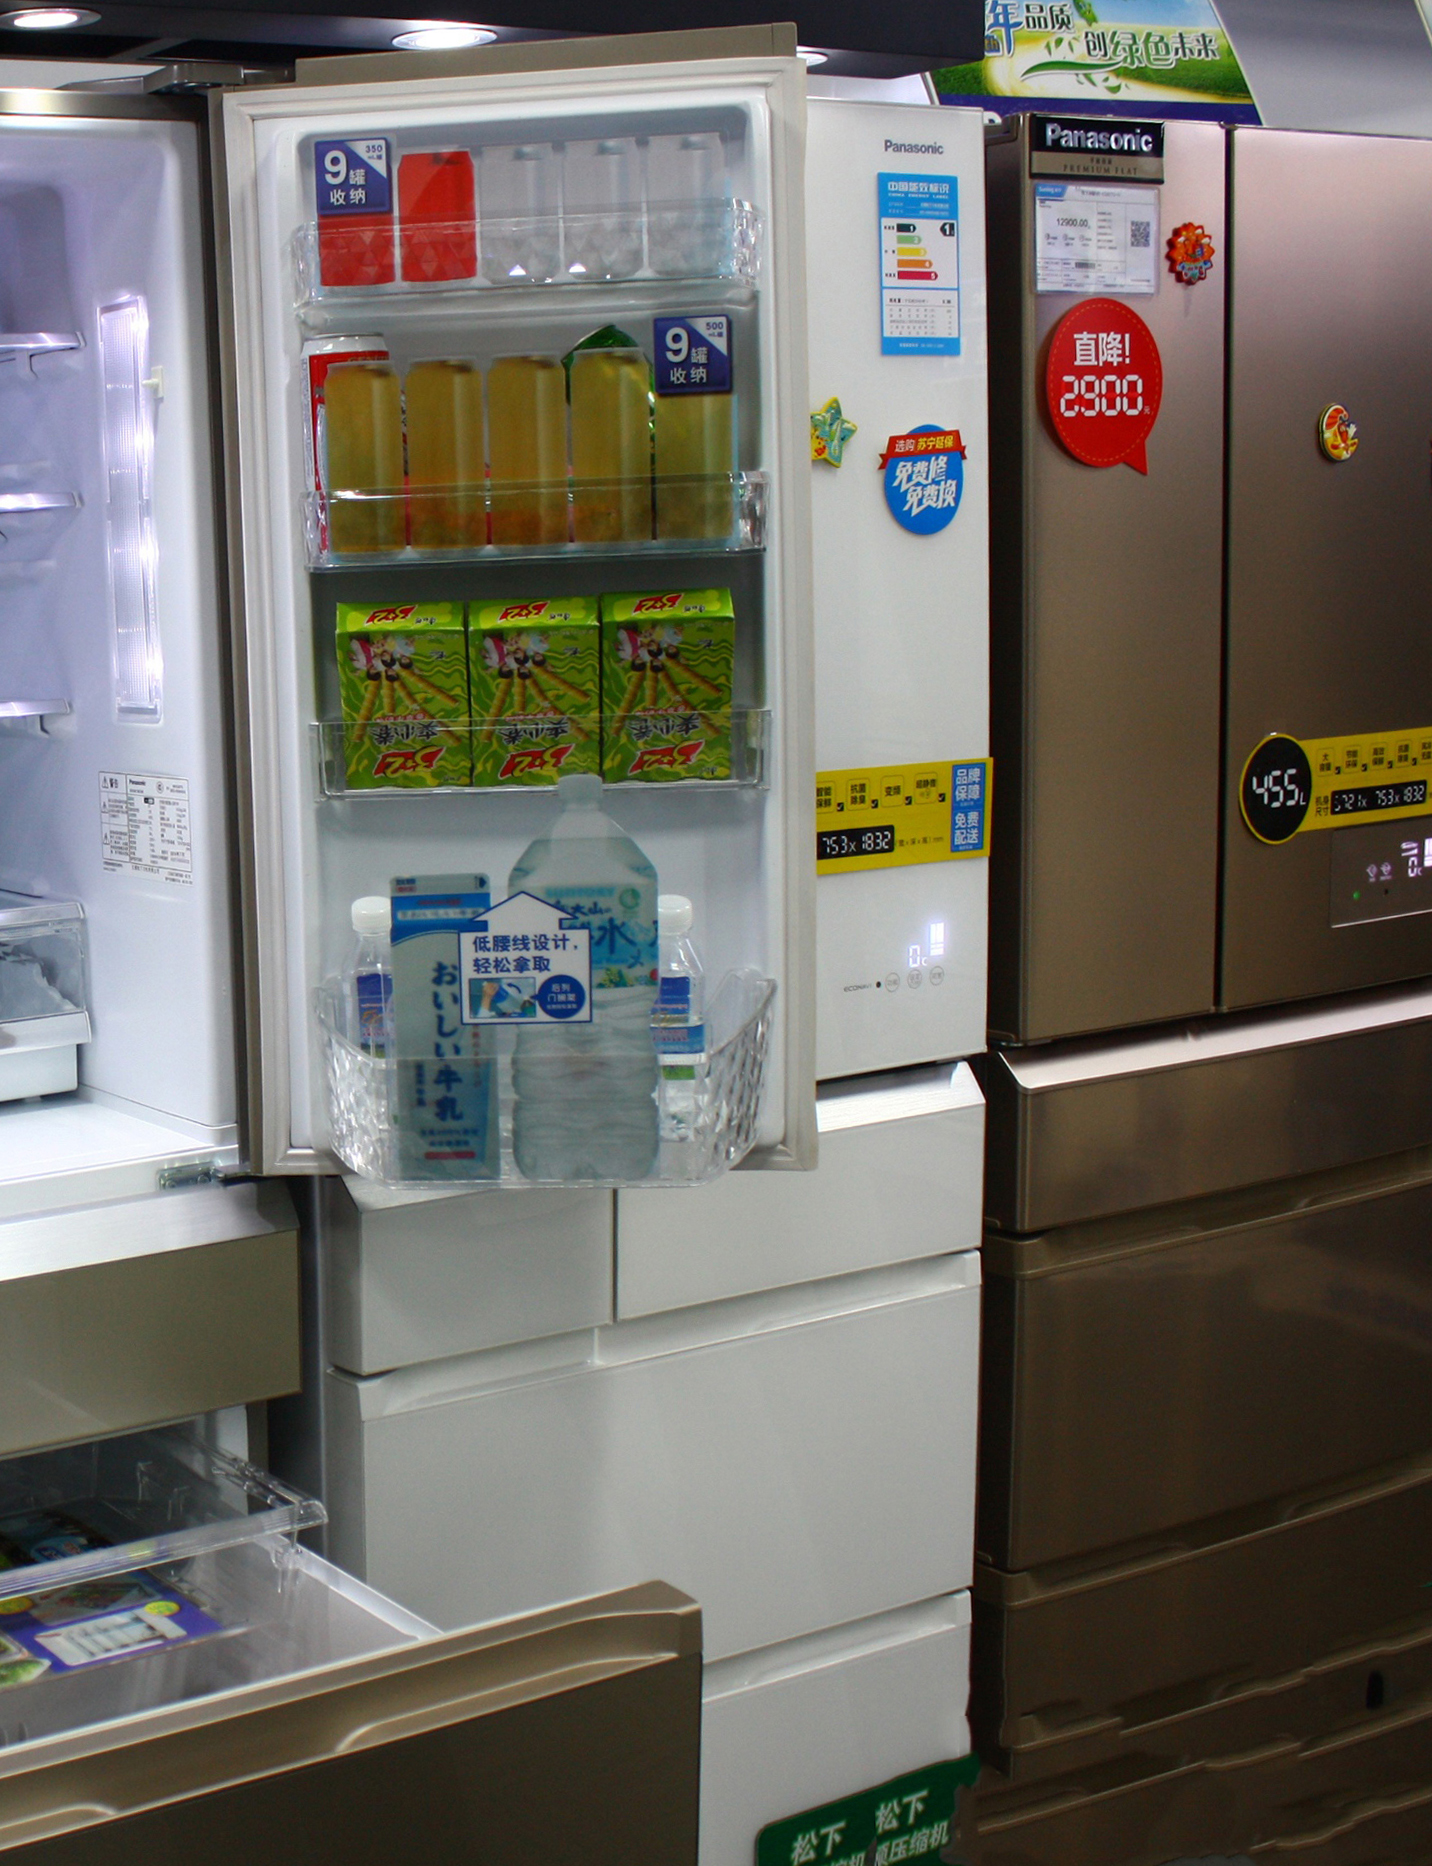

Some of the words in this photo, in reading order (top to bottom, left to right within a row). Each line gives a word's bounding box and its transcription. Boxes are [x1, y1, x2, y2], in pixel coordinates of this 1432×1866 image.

[1084, 31, 1219, 67] 创绿色未来
[365, 144, 383, 153] 350
[884, 139, 944, 155] Panasonic
[1046, 122, 1153, 152] Panasonic
[329, 188, 367, 206] 收纳
[706, 322, 724, 330] 500
[1073, 331, 1131, 367] 直降!
[670, 366, 707, 385] 收纳
[894, 438, 916, 452] 选购
[892, 454, 949, 493] 免费修
[902, 478, 957, 518] 免费换
[861, 830, 890, 850] 1832
[472, 955, 551, 974] 轻松拿取
[431, 960, 465, 1122] おいしい牛乳
[875, 1788, 930, 1835] 松下
[790, 1819, 848, 1866] 松下
